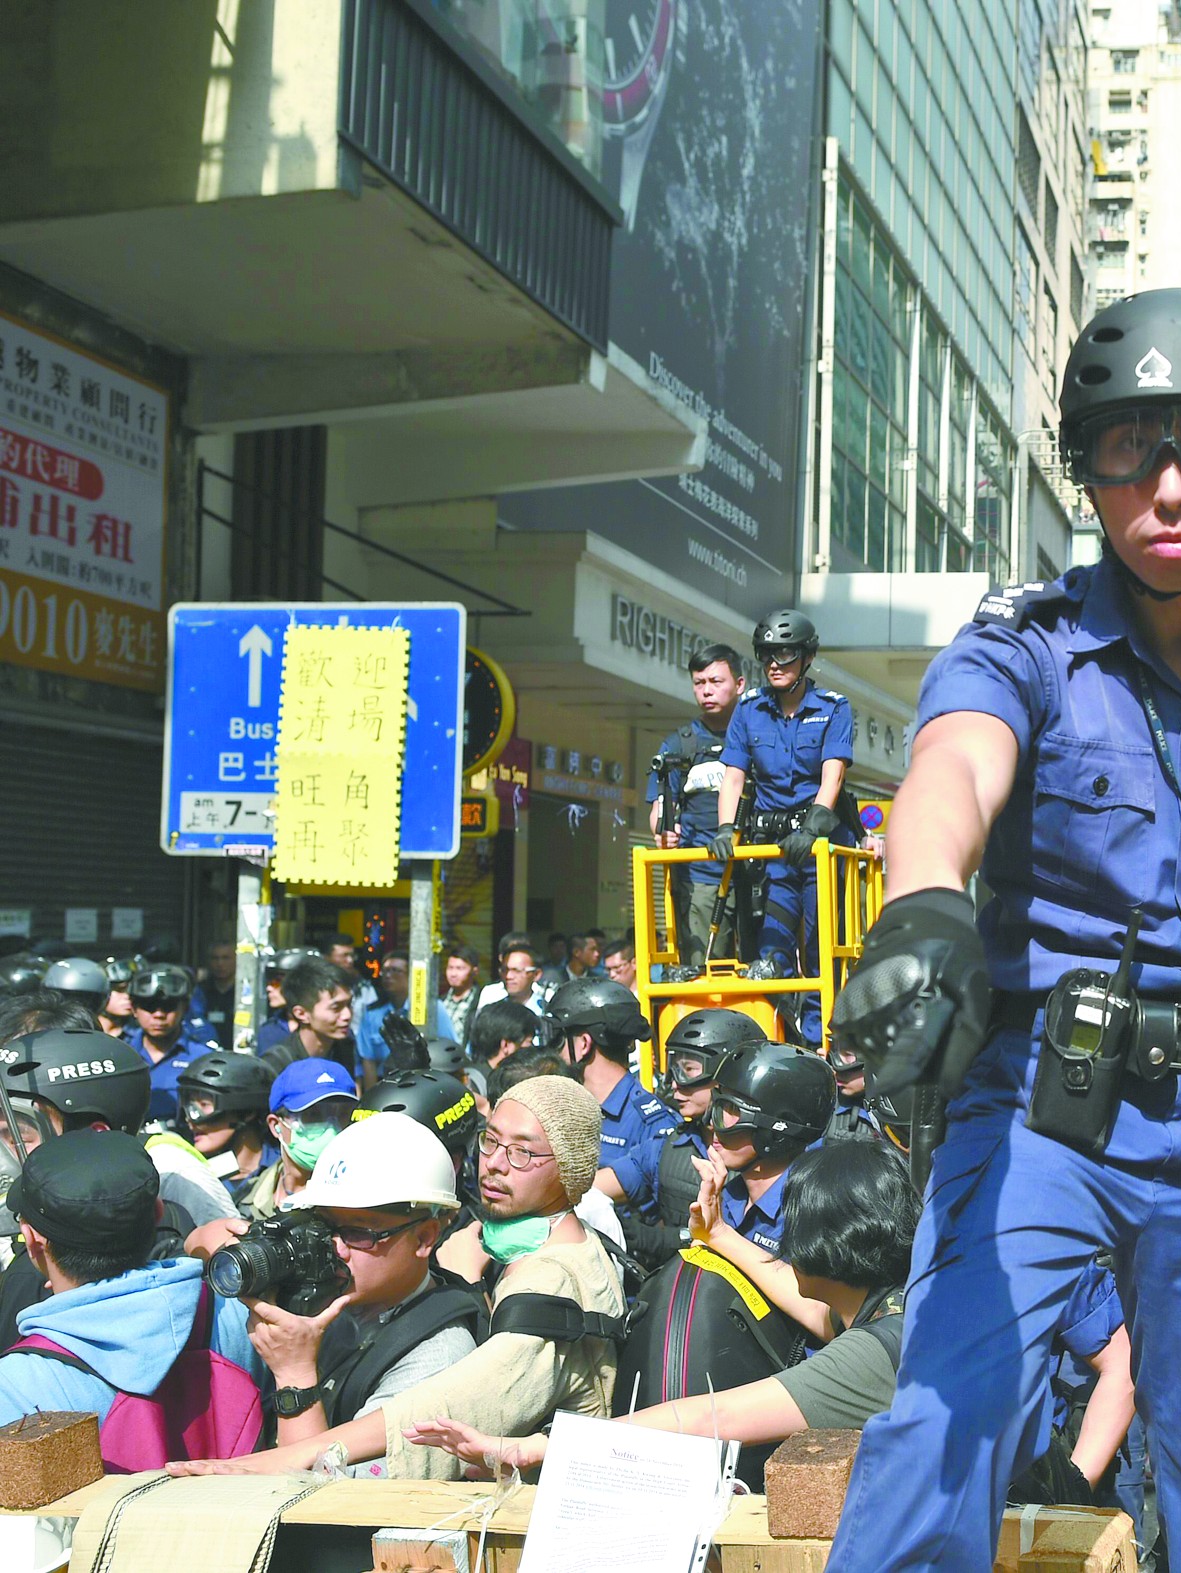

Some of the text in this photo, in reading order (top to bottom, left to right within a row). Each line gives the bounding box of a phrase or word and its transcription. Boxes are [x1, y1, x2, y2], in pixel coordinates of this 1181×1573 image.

[650, 351, 695, 408] Discover
[695, 391, 711, 422] the
[230, 717, 274, 740] Bus
[218, 752, 277, 782] 巴士
[194, 798, 215, 808] am
[290, 769, 370, 810] 旺角
[47, 1059, 117, 1083] PRESS
[434, 1091, 476, 1130] PRESS
[611, 1447, 640, 1462] Notice
